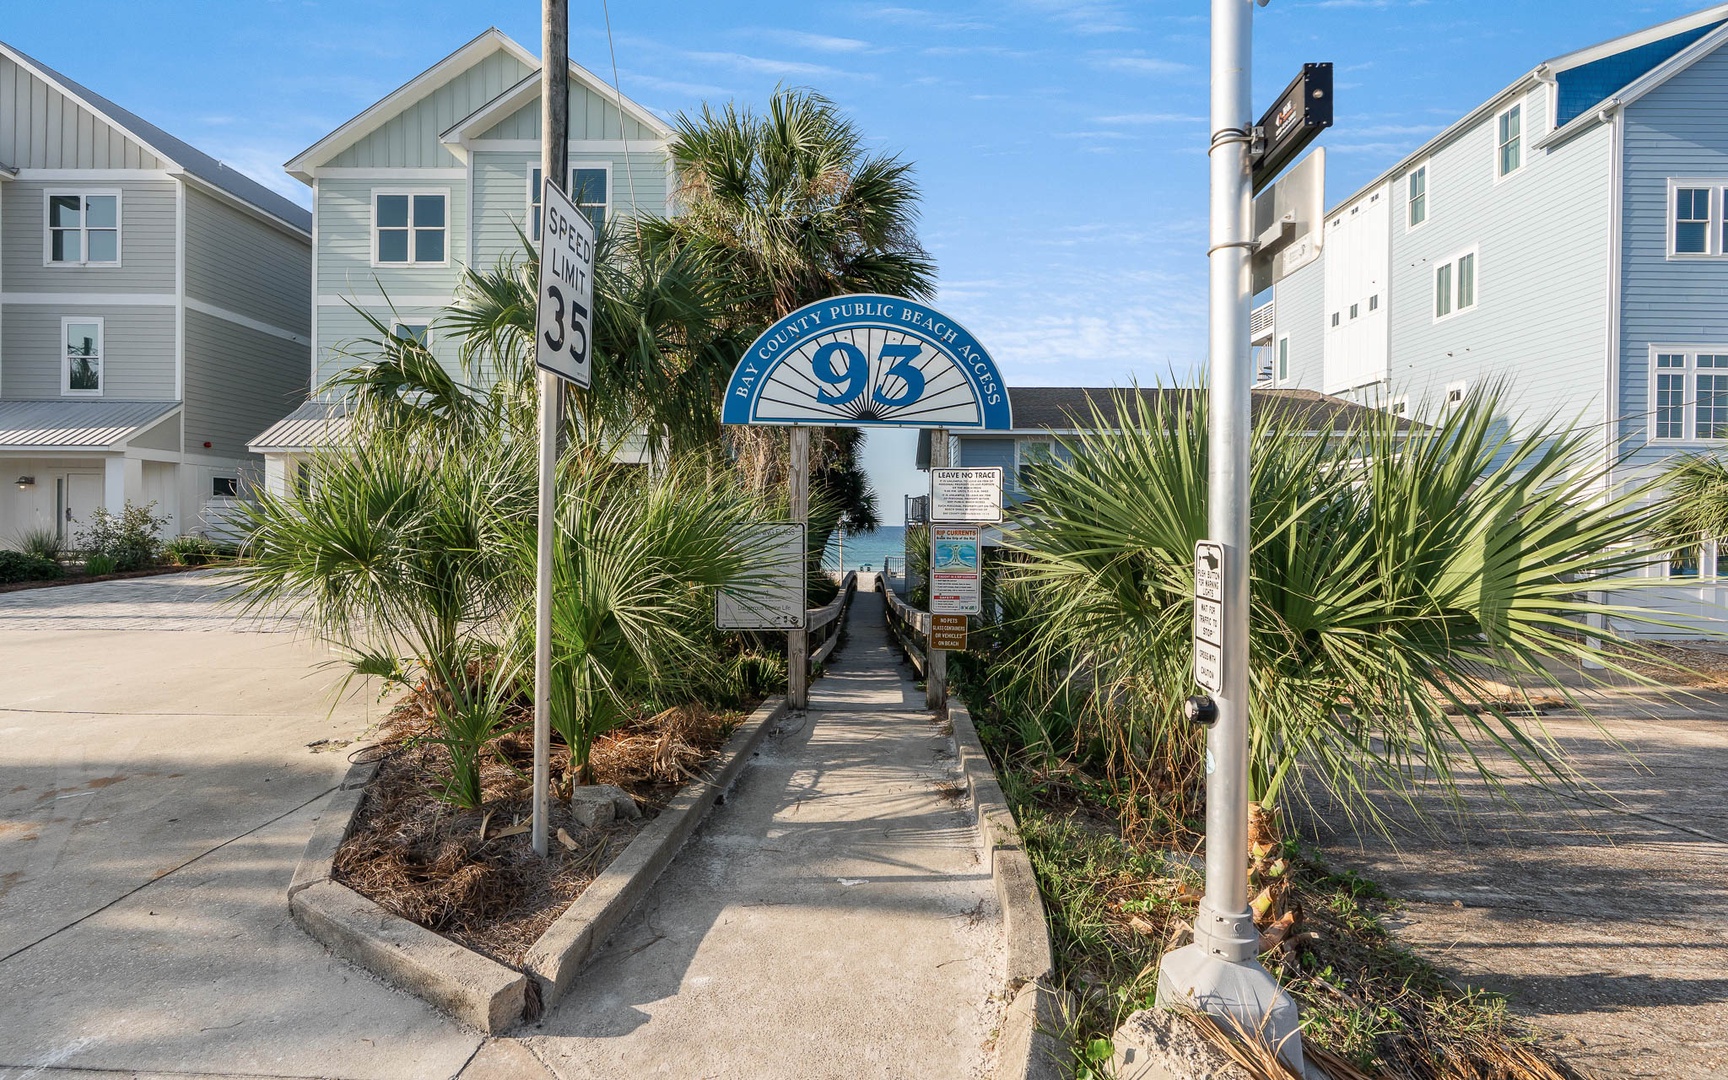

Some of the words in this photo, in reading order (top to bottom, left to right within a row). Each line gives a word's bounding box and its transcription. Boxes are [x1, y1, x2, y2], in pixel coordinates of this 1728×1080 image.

[548, 206, 591, 265] SPEED
[552, 247, 586, 296] LIMIT
[544, 285, 588, 365] 35
[735, 362, 759, 399] BAY
[758, 310, 822, 360] COUNTY
[830, 303, 894, 320] PUBLIC
[900, 308, 959, 344] BEACH
[958, 344, 1001, 406] ACCESS
[812, 341, 926, 407] 93
[1197, 569, 1206, 578] PUSH
[1207, 570, 1220, 581] BUTTON
[1205, 580, 1219, 590] WARNING
[1202, 588, 1214, 598] LIGHTS
[1199, 614, 1211, 626] TRAFFIC
[1199, 649, 1209, 661] CROSS
[1209, 654, 1217, 664] WITH
[1201, 666, 1215, 680] CAUTION
